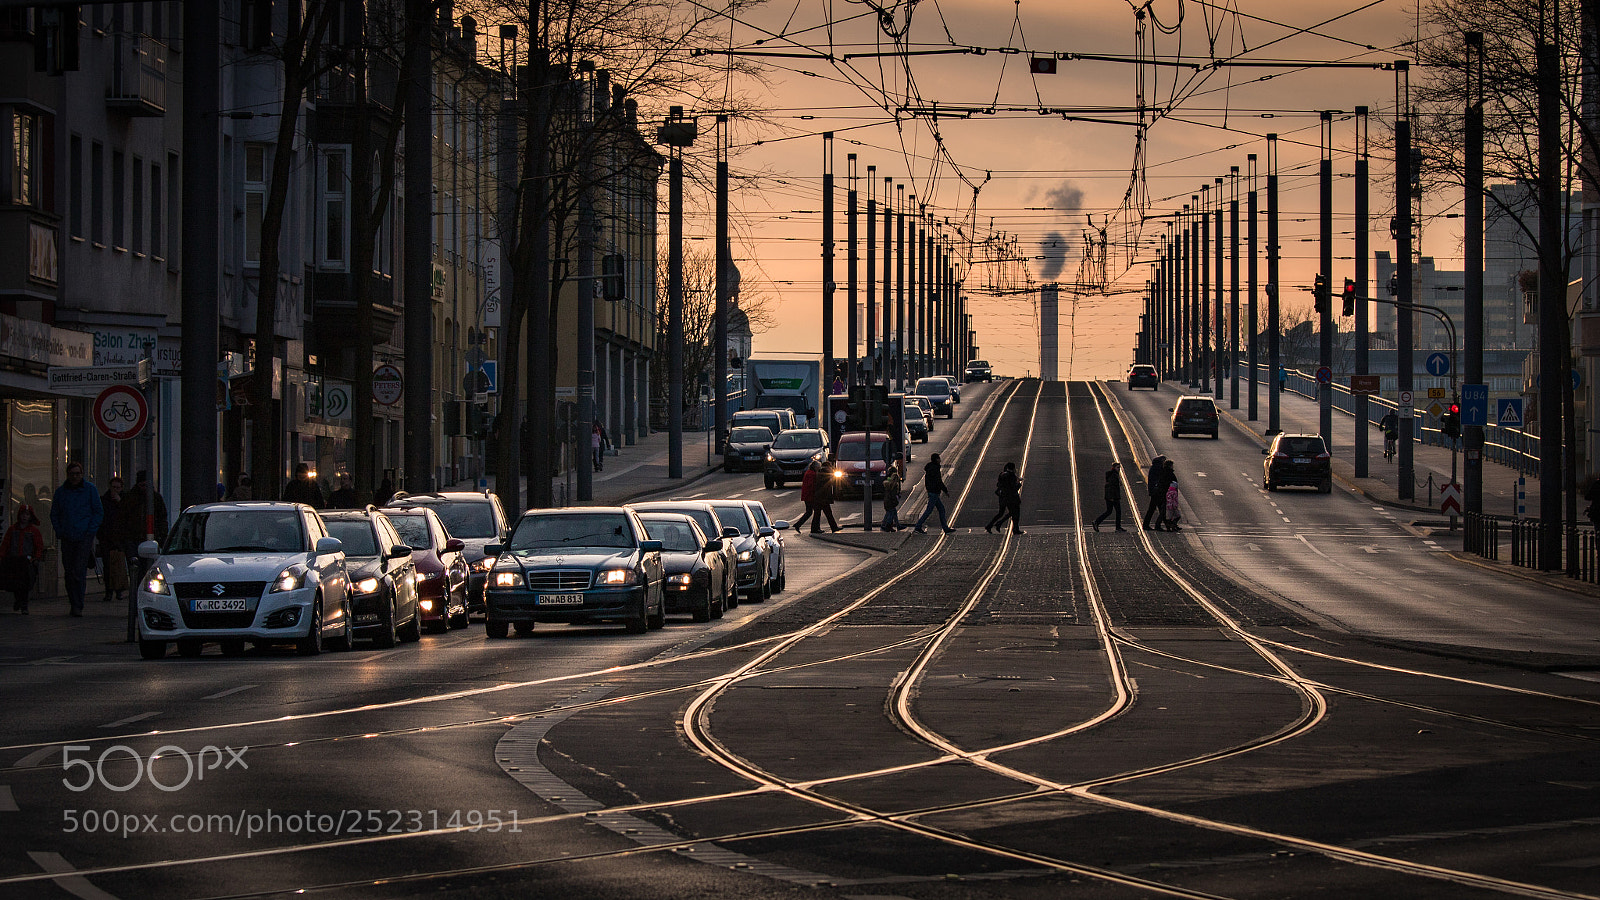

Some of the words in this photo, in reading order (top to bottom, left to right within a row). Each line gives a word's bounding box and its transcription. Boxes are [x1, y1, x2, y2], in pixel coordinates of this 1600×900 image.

[94, 331, 122, 347] Salon
[128, 333, 156, 349] Zhala
[52, 371, 136, 383] Gottfried-Claren-Straße
[374, 381, 400, 389] PETERS
[540, 596, 550, 604] BN
[556, 596, 566, 604] AB
[196, 601, 202, 610] K
[208, 601, 220, 610] RC
[222, 601, 244, 610] 3492
